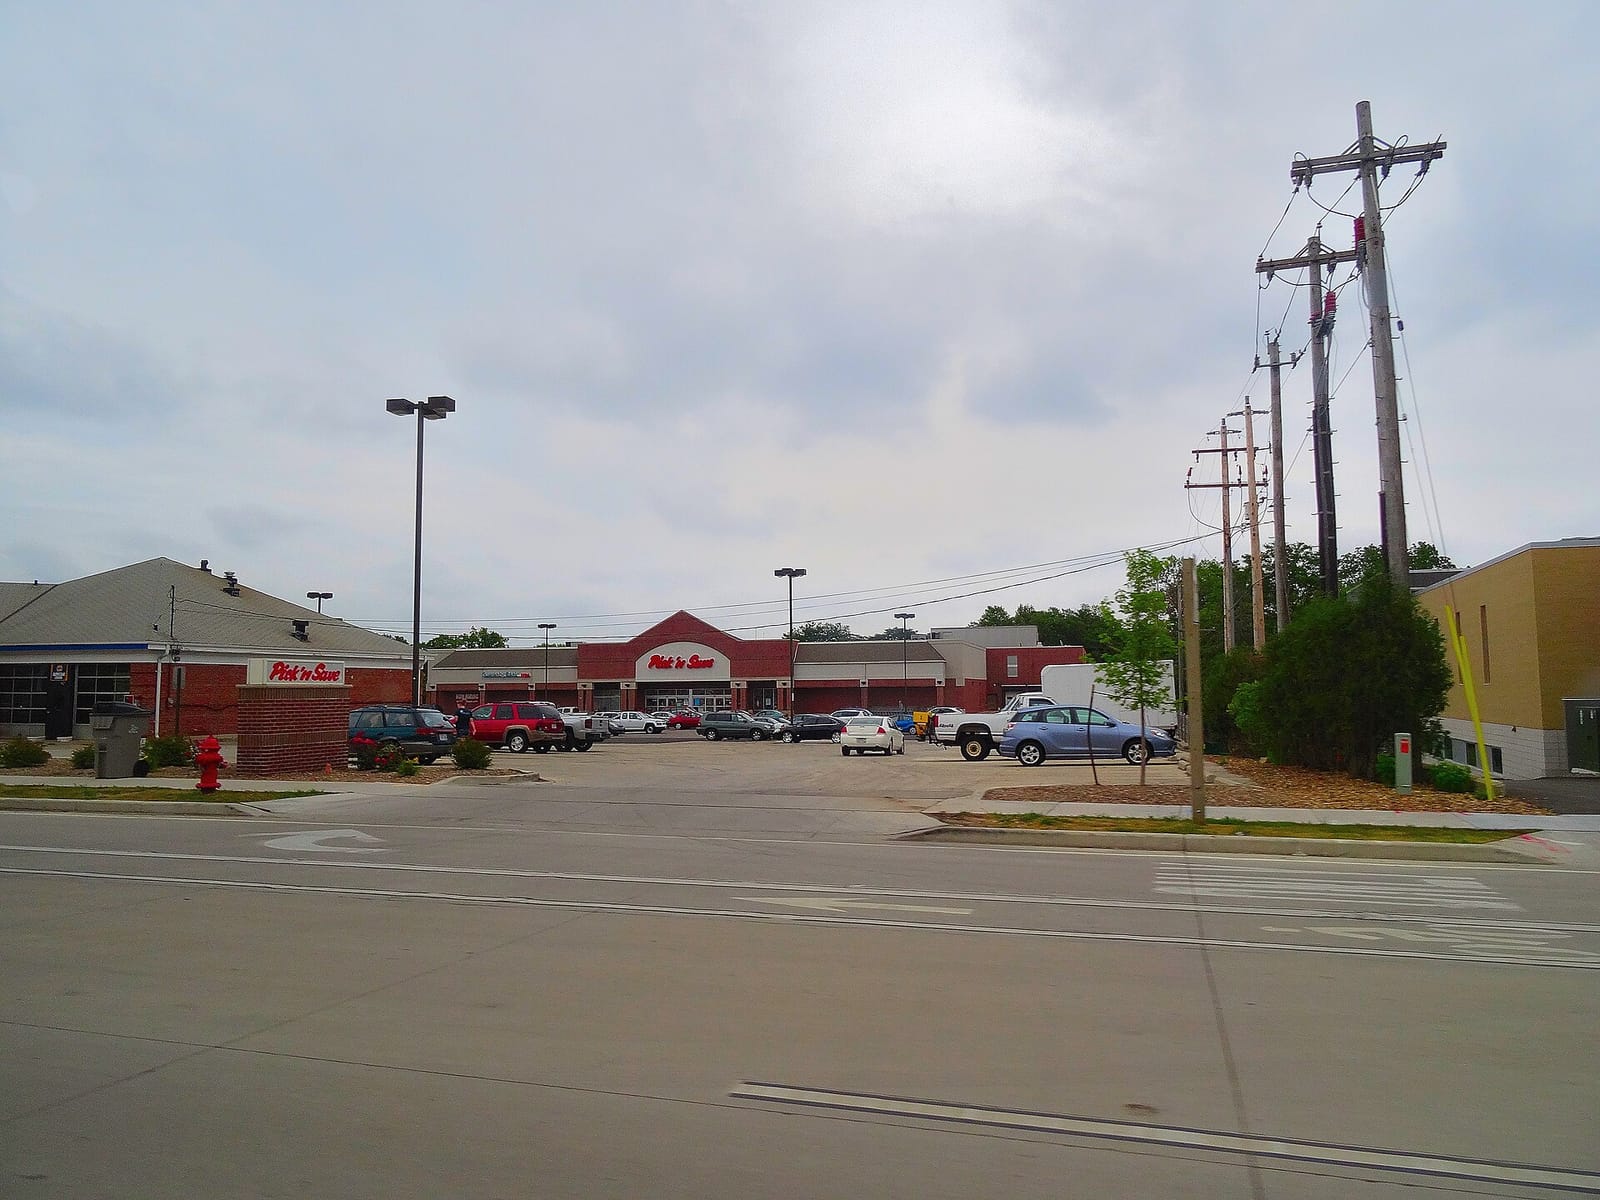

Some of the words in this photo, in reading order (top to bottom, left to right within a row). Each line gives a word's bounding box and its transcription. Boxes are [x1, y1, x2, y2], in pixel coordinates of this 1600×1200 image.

[647, 654, 673, 669] Pick
[269, 661, 299, 681] Pick
[312, 662, 341, 681] Save
